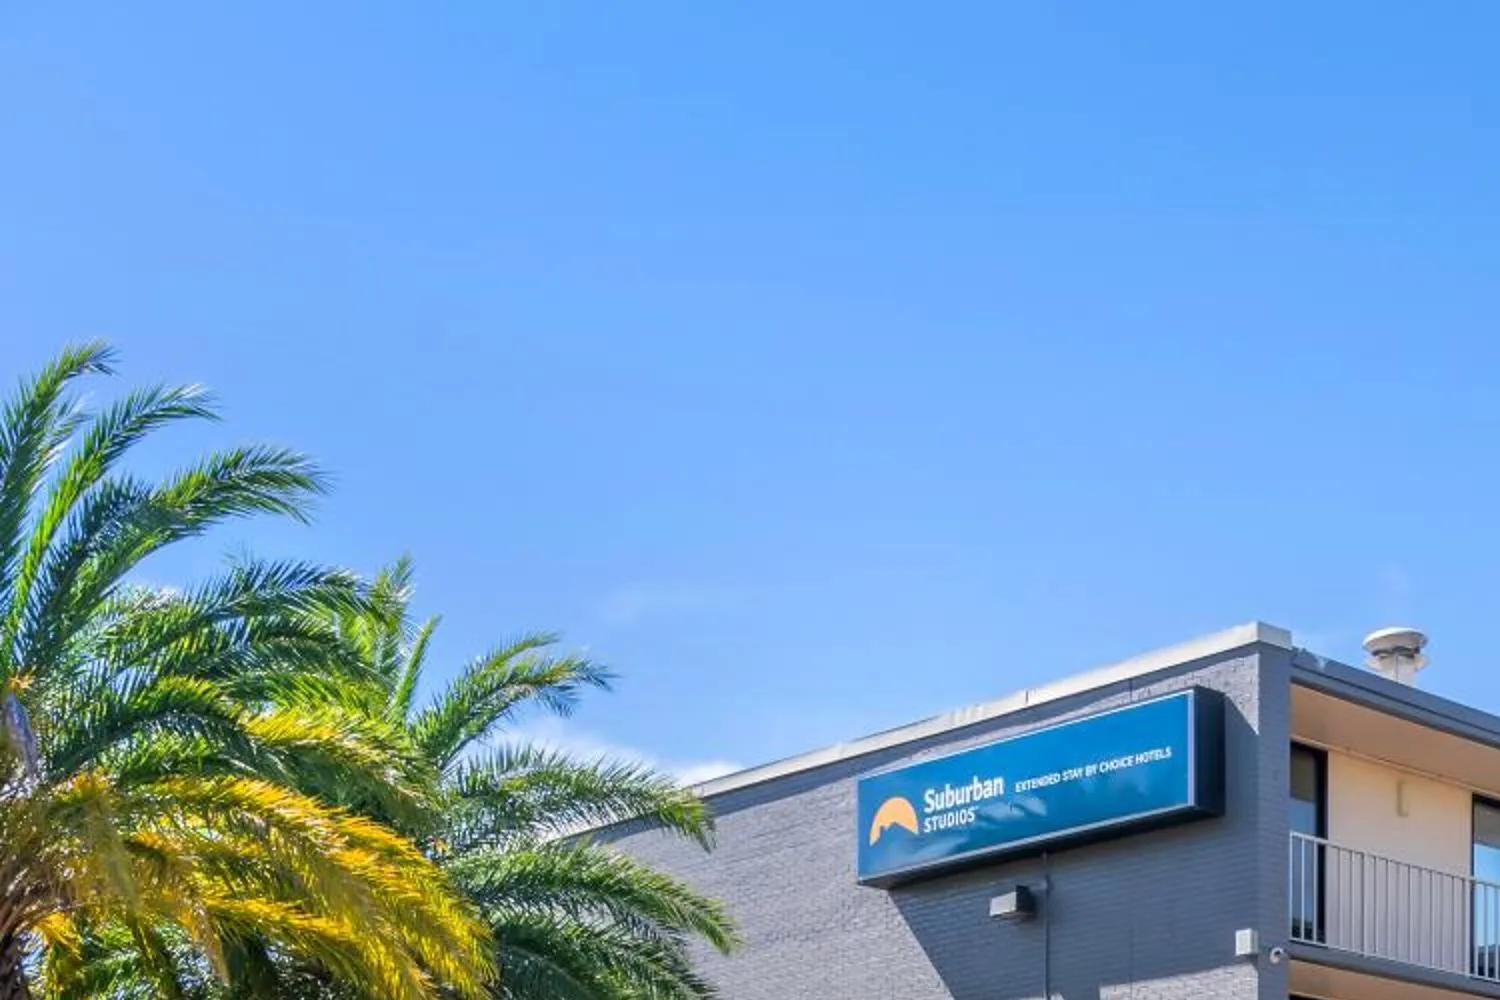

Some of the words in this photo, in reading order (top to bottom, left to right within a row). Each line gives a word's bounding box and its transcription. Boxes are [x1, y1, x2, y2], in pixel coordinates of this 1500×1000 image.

[1015, 772, 1061, 792] EXTENDED
[1062, 768, 1083, 782] STAY
[1085, 764, 1098, 776] BY
[1099, 756, 1134, 773] CHOICE
[1135, 746, 1172, 764] HOTELS
[924, 775, 1004, 813] Suburban
[924, 806, 976, 833] STUDIOS
